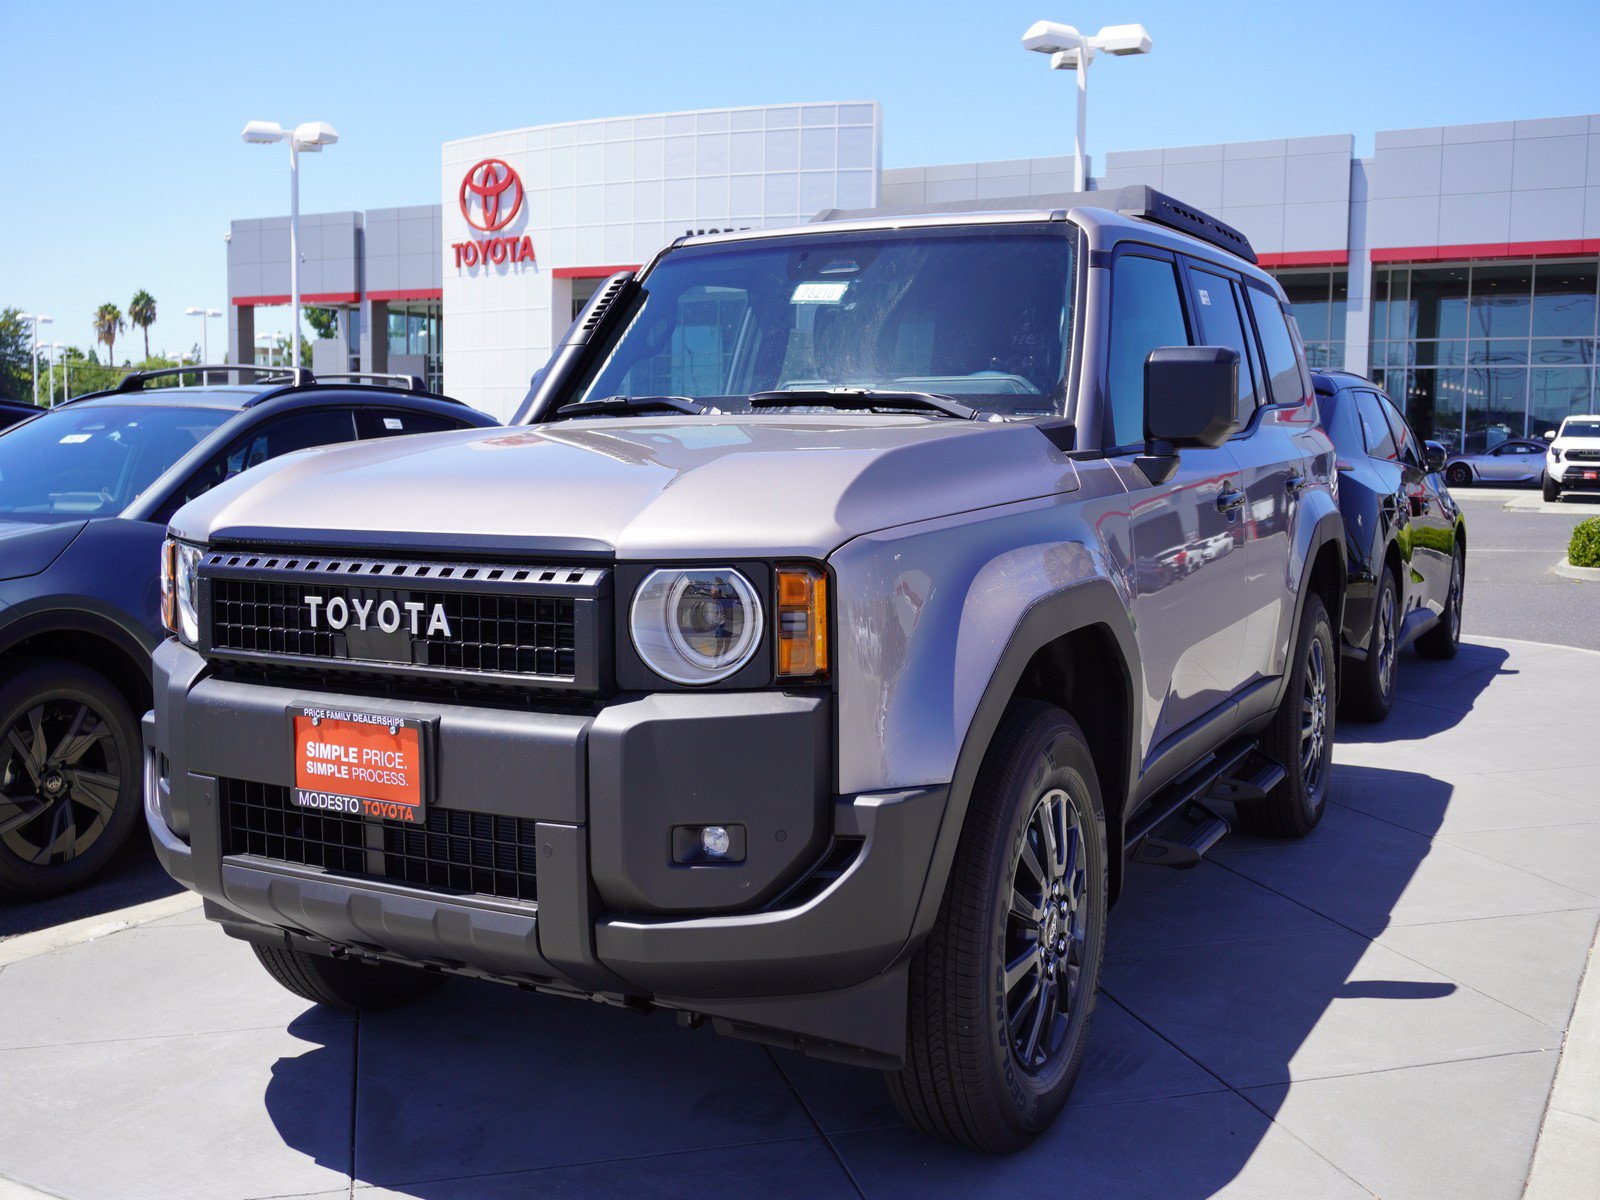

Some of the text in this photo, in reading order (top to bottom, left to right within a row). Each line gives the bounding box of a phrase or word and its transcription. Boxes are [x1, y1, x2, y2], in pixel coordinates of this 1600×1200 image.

[451, 235, 535, 268] TOYOTA
[304, 596, 452, 637] TOYOTA
[304, 708, 405, 727] PRICE FAMILY DEALERSHIPS
[306, 741, 408, 769] SIMPLE PRICE.
[306, 760, 409, 786] SIMPLE PROCESS.
[299, 791, 415, 821] MODESTO TOYOTA
